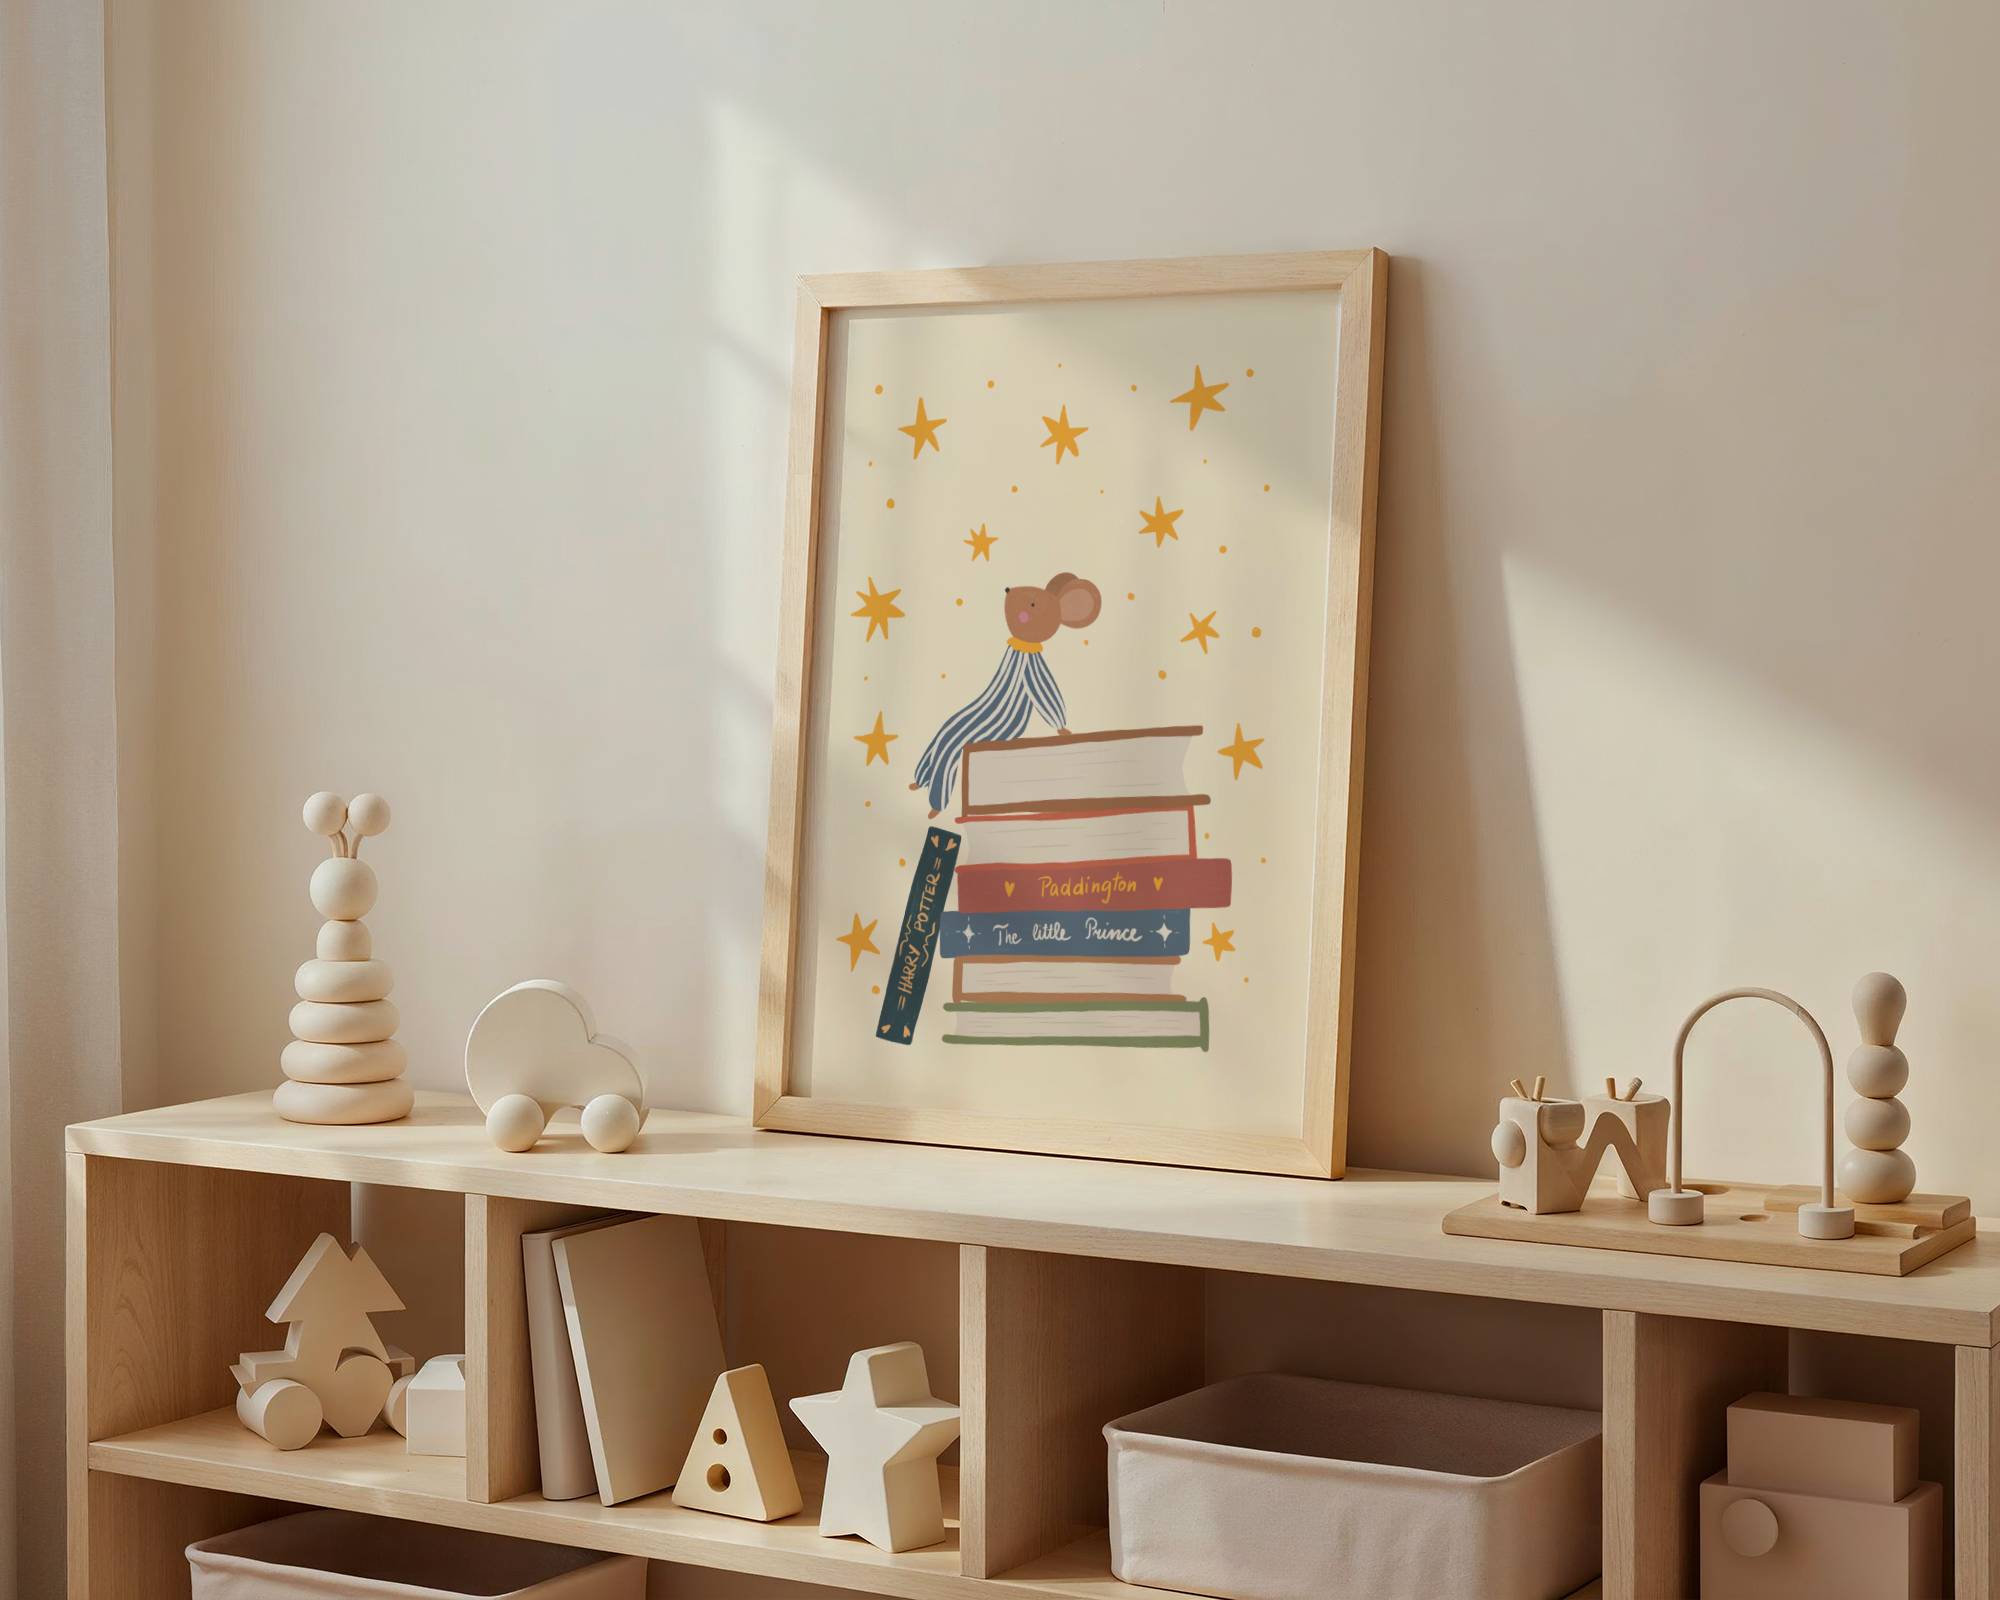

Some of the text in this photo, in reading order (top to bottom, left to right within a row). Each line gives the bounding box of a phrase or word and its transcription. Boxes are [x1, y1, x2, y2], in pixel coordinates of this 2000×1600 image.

[1038, 871, 1138, 905] Paddington
[898, 872, 940, 995] HARRY POTTER
[992, 917, 1144, 946] The little Prince
